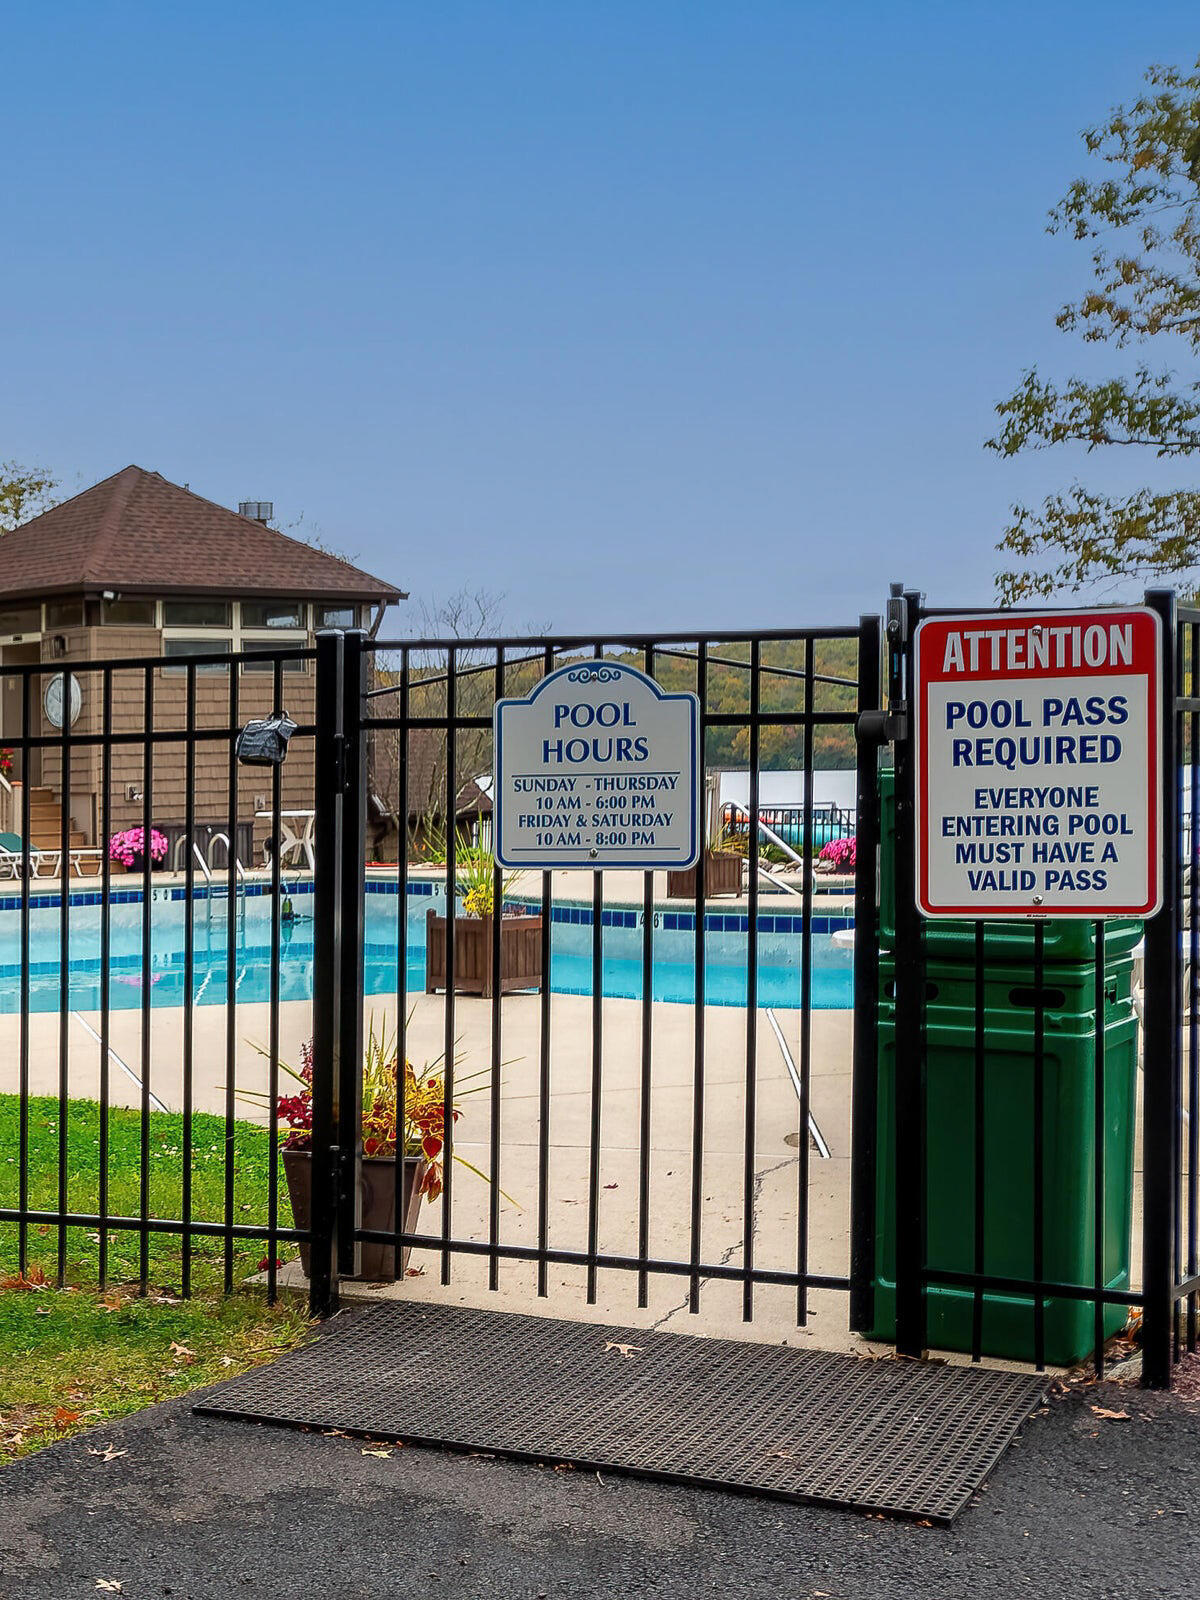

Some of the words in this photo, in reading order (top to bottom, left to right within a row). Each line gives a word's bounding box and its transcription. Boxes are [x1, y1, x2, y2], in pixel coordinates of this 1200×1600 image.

[942, 624, 1133, 673] ATTENTION
[554, 703, 636, 728] POOL
[946, 700, 1032, 729] POOL
[1043, 696, 1128, 726] PASS
[543, 737, 649, 763] HOURS
[953, 735, 1121, 770] REQUIRED
[514, 778, 577, 792] SUNDAY
[594, 776, 679, 790] THURSDAY
[536, 797, 553, 810] 10
[557, 796, 581, 809] AM
[596, 796, 627, 809] 6:00
[632, 795, 655, 808] PM
[974, 786, 1099, 809] EVERYONE
[518, 815, 571, 828] FRIDAY
[576, 815, 587, 827] &
[591, 813, 673, 827] SATURDAY
[942, 815, 1059, 836] ENTERING
[1068, 814, 1133, 835] POOL
[536, 833, 553, 846] 10
[557, 832, 581, 845] AM
[596, 832, 627, 845] 8:00
[632, 832, 655, 845] PM
[956, 842, 1024, 863] MUST
[1032, 842, 1094, 862] HAVE
[1101, 842, 1118, 862] A
[968, 870, 1036, 891] VALID
[1045, 870, 1107, 890] PASS
